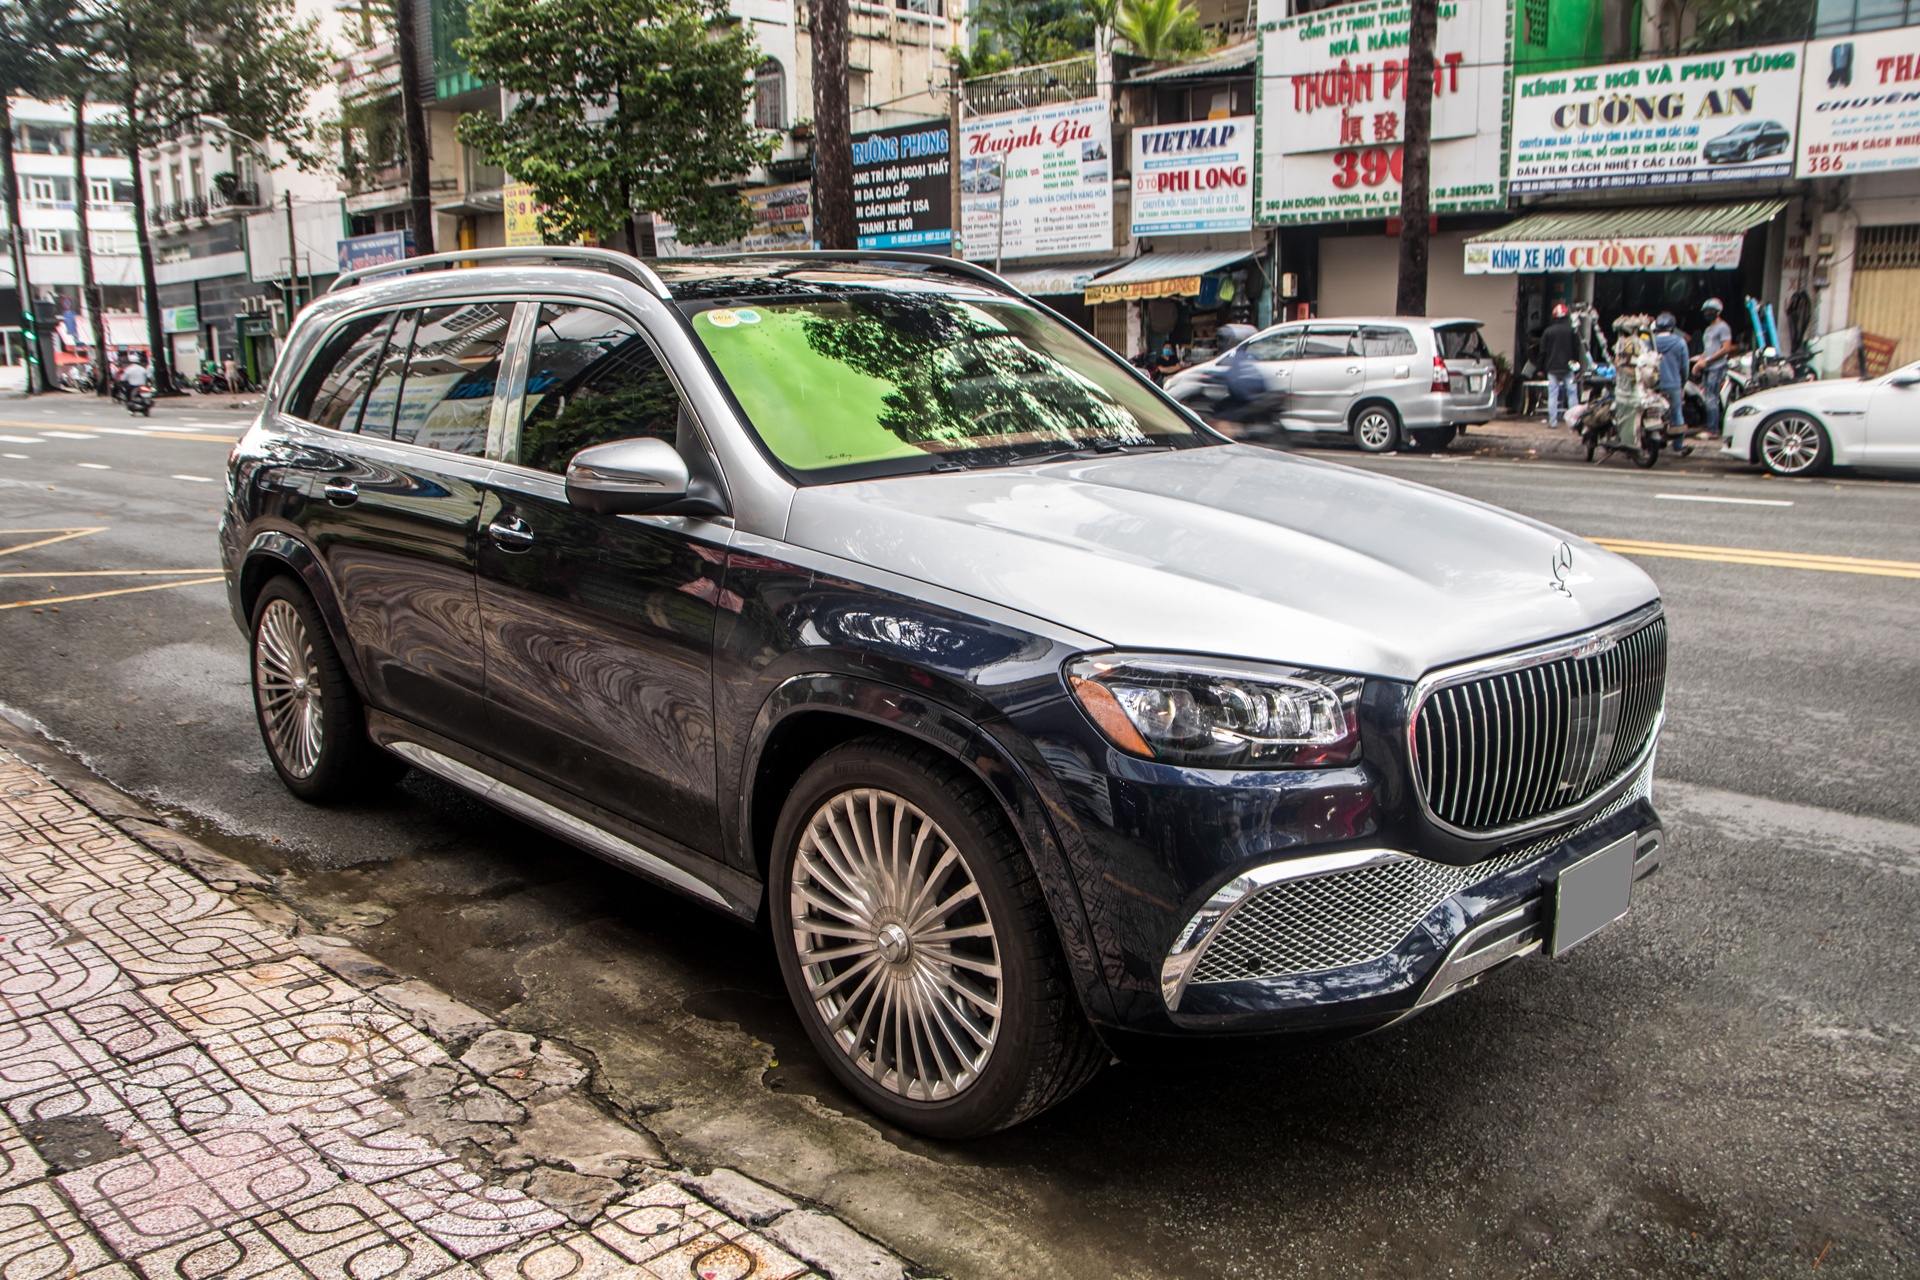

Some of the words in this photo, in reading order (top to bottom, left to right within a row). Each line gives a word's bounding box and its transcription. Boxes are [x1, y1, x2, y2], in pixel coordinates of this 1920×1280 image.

[1300, 23, 1325, 41] CÔNG
[1330, 21, 1342, 35] TY
[1347, 15, 1375, 32] TNHH
[1379, 9, 1411, 27] THƯƠ
[1329, 35, 1360, 57] NHÀ
[1291, 58, 1373, 116] THUẬN
[1383, 52, 1463, 101] PT
[1521, 77, 1567, 97] KÍNH
[1572, 75, 1597, 91] XE
[1605, 70, 1639, 89] HƠI
[1647, 64, 1672, 84] VÀ
[1681, 60, 1725, 82] PHỤ
[1733, 52, 1796, 75] TÙNG
[1553, 93, 1684, 129] CƯỜNG
[1696, 85, 1756, 118] AN
[852, 134, 898, 165] RƯỜNG
[901, 129, 949, 158] PHONG
[968, 125, 1044, 155] Huỳnh
[1049, 119, 1092, 148] Gia
[1142, 125, 1235, 155] VIETMAP
[1833, 140, 1859, 152] FILM
[1863, 136, 1892, 150] CÁCH
[853, 172, 870, 185] ANG
[871, 167, 884, 183] TRÍ
[886, 165, 899, 182] NỘI
[902, 164, 925, 180] NGOẠI
[928, 157, 950, 176] THẤT
[1043, 161, 1057, 170] CAM
[1059, 169, 1079, 177] TRANG
[1517, 165, 1539, 176] DÁN
[1542, 164, 1567, 175] FILM
[1571, 161, 1600, 173] CÁCH
[1604, 156, 1639, 172] NHIỆT
[1642, 155, 1665, 168] CÁC
[1669, 155, 1697, 168] LOẠI
[1808, 154, 1843, 174] 386
[864, 188, 874, 200] DA
[876, 186, 891, 198] CAO
[893, 180, 909, 197] CẤP
[1158, 171, 1190, 193] PHI
[1194, 166, 1247, 190] LONG
[865, 202, 885, 216] CÁCH
[888, 198, 911, 216] NHIỆT
[913, 198, 930, 212] USA
[1282, 198, 1294, 209] AN
[1295, 194, 1326, 208] DƯƠNG
[859, 222, 884, 235] THANH
[887, 220, 896, 232] XE
[899, 216, 913, 230] HƠI
[1492, 244, 1520, 269] KÍNH
[1523, 247, 1539, 267] XE
[1545, 245, 1565, 268] HƠI
[1569, 238, 1655, 269] CƯỜNG
[1662, 243, 1702, 266] AN
[1160, 277, 1196, 294] LONG
